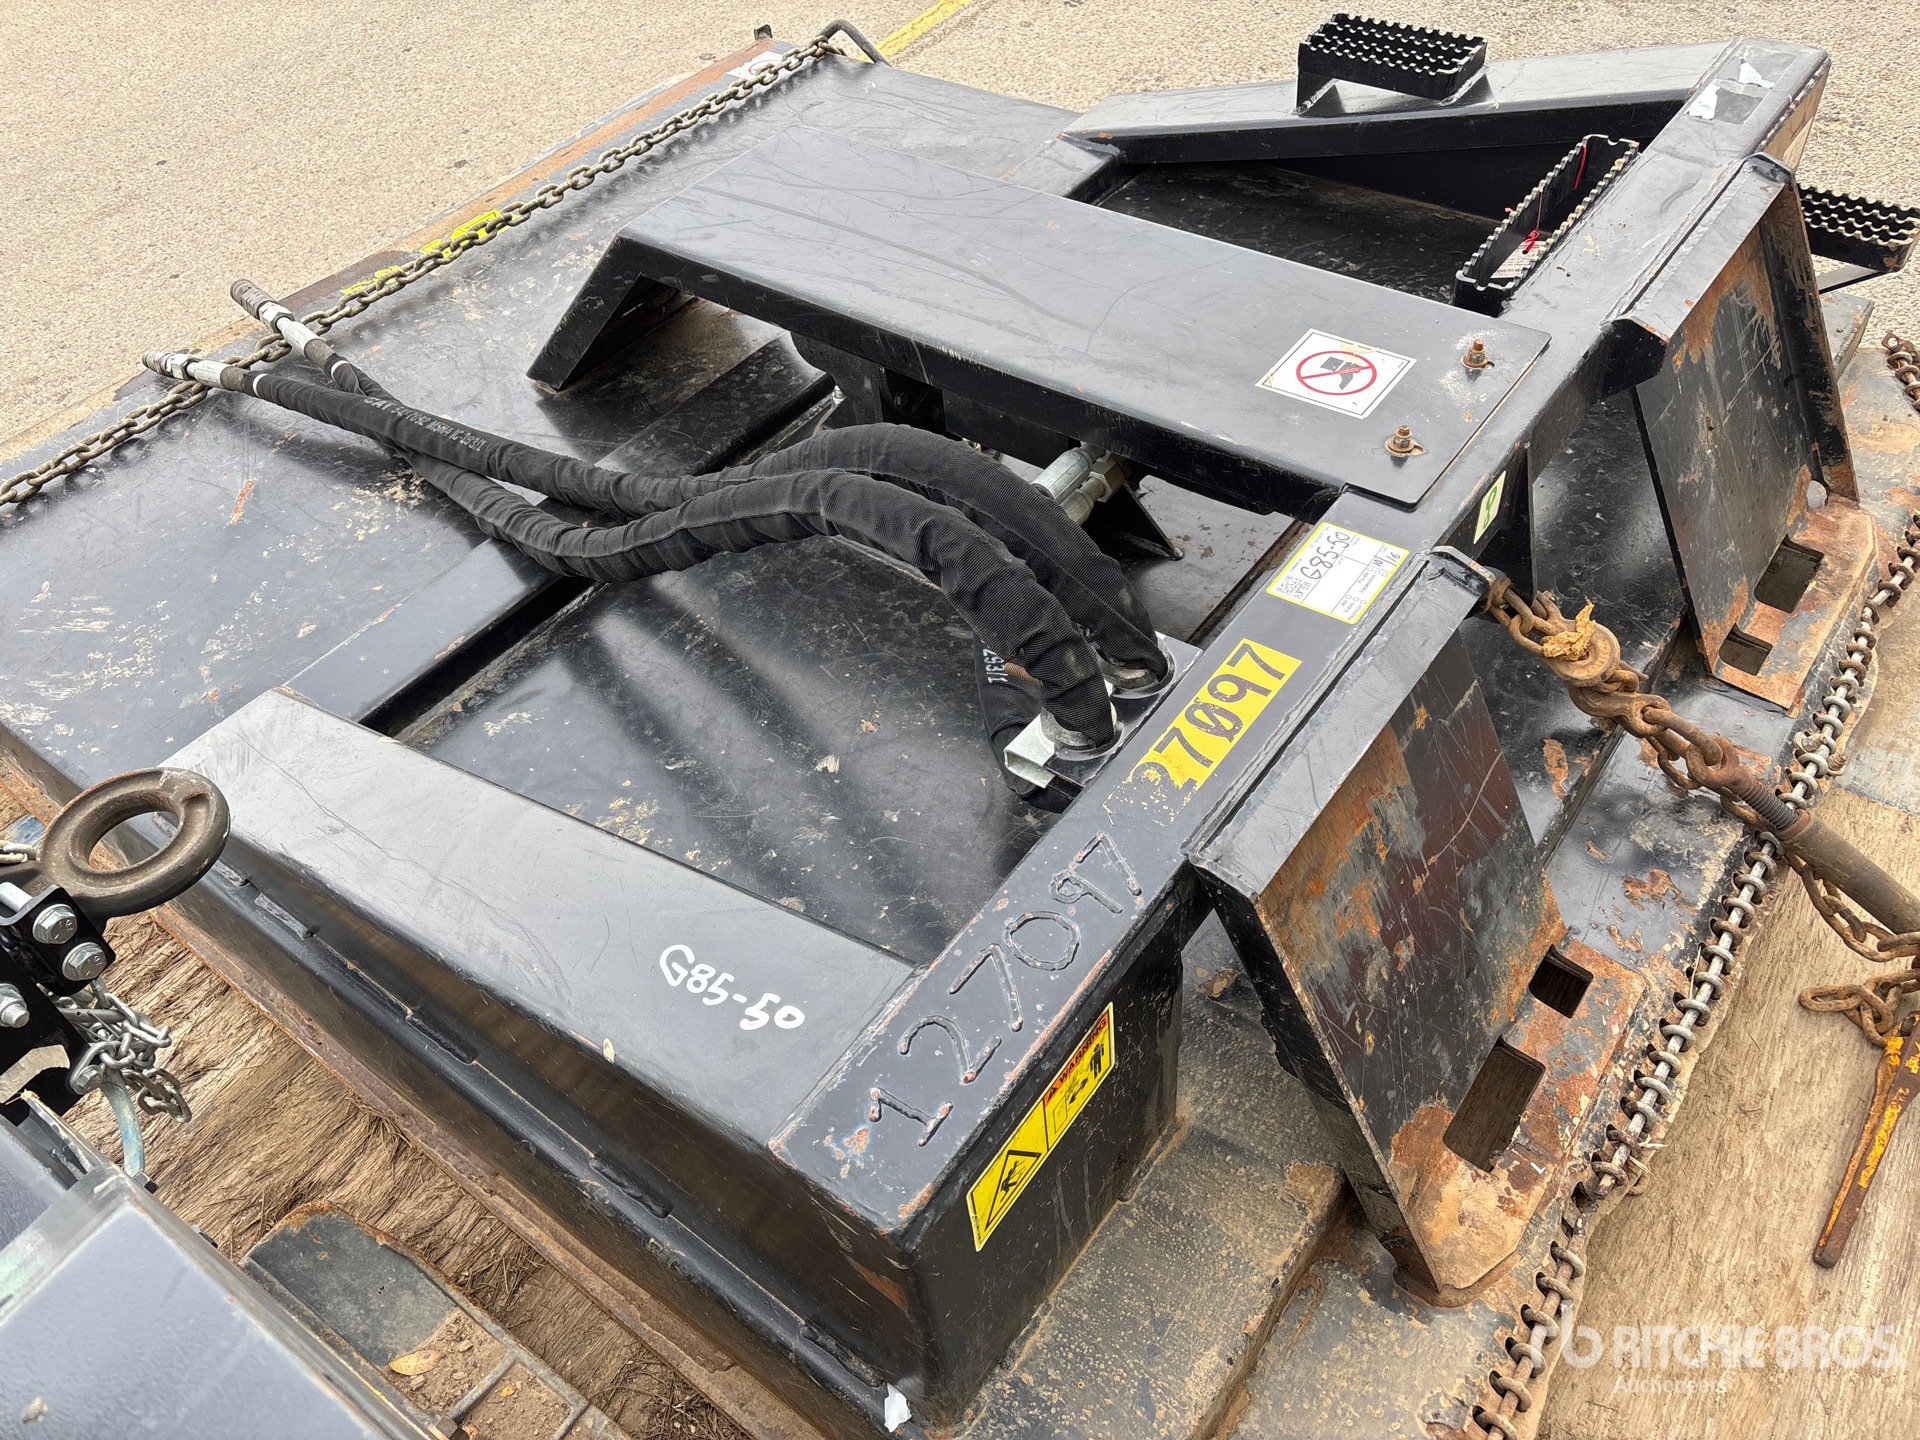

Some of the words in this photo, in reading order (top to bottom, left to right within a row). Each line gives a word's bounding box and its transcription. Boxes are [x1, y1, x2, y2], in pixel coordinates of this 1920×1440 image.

[364, 397, 396, 410] CAT
[1300, 531, 1350, 580] G85-50
[1121, 642, 1286, 809] 27097
[659, 944, 806, 1030] G85-50
[867, 831, 1143, 1148] 127097
[1059, 1018, 1106, 1083] WARNING
